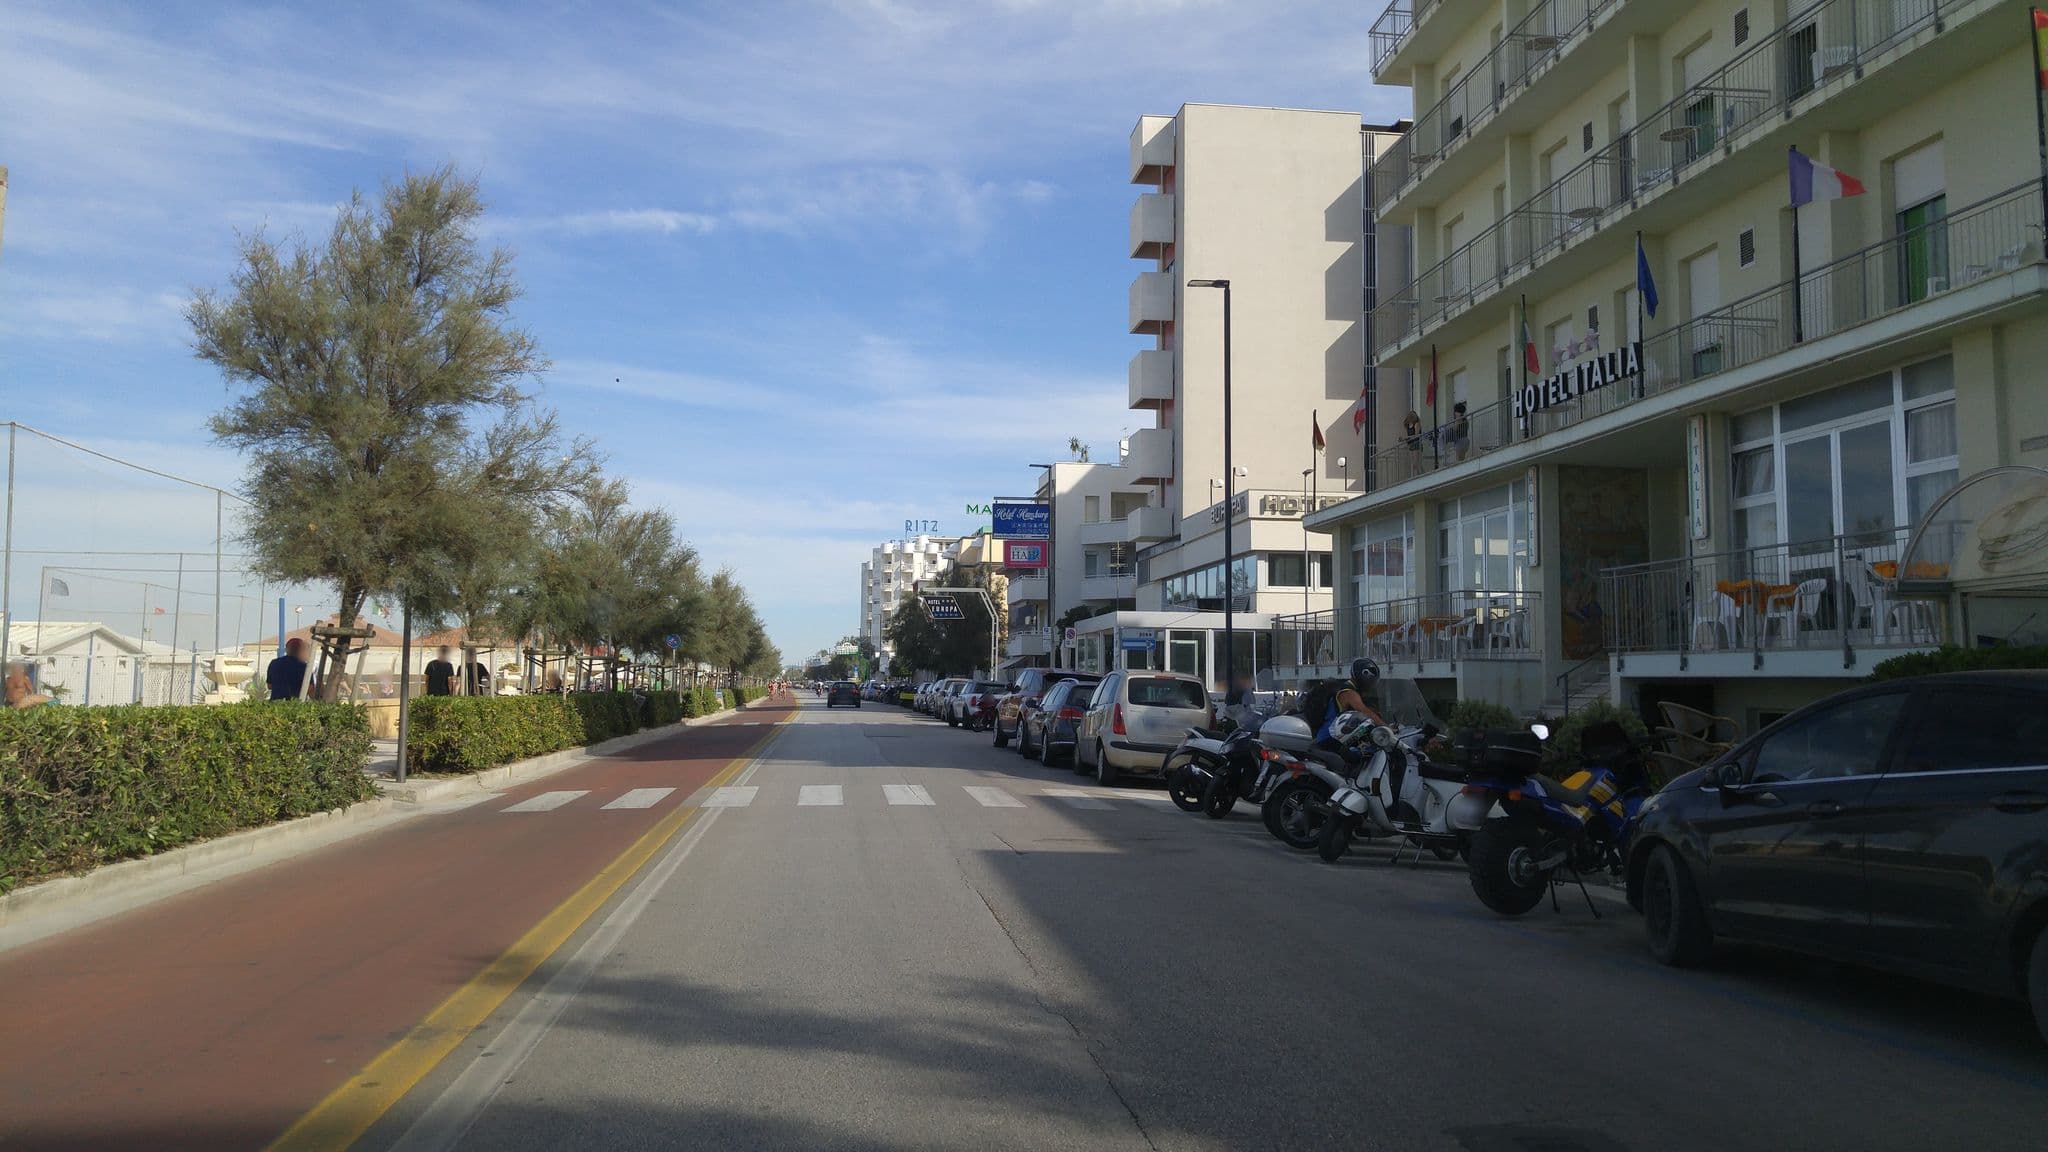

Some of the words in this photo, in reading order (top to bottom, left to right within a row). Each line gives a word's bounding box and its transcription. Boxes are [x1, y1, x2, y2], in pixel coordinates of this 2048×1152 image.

[1513, 373, 1568, 418] HOTEL
[1573, 342, 1640, 396] ITALIA
[1693, 427, 1702, 528] ITALIA
[966, 504, 992, 514] MA
[1210, 496, 1245, 526] EURPA
[905, 520, 938, 532] RITZ
[931, 605, 958, 613] EUROPA
